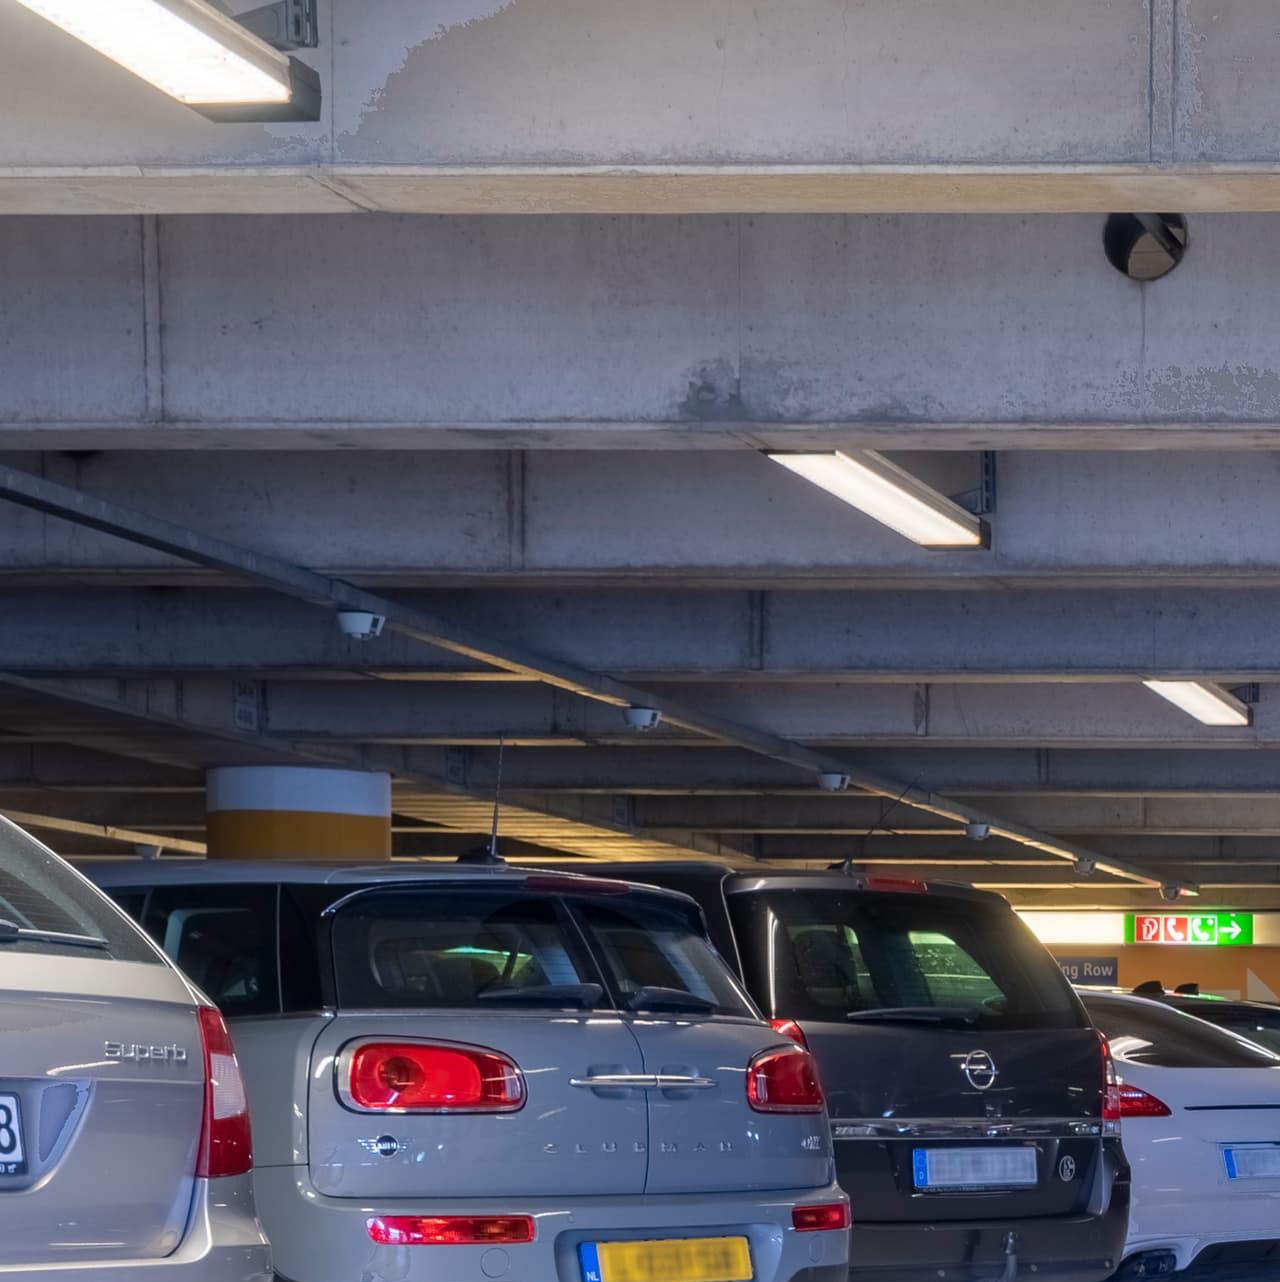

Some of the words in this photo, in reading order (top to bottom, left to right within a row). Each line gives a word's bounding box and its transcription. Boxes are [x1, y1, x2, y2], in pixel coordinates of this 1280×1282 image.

[1083, 962, 1113, 977] Row
[104, 1041, 187, 1061] Superb
[586, 1271, 599, 1282] NL
